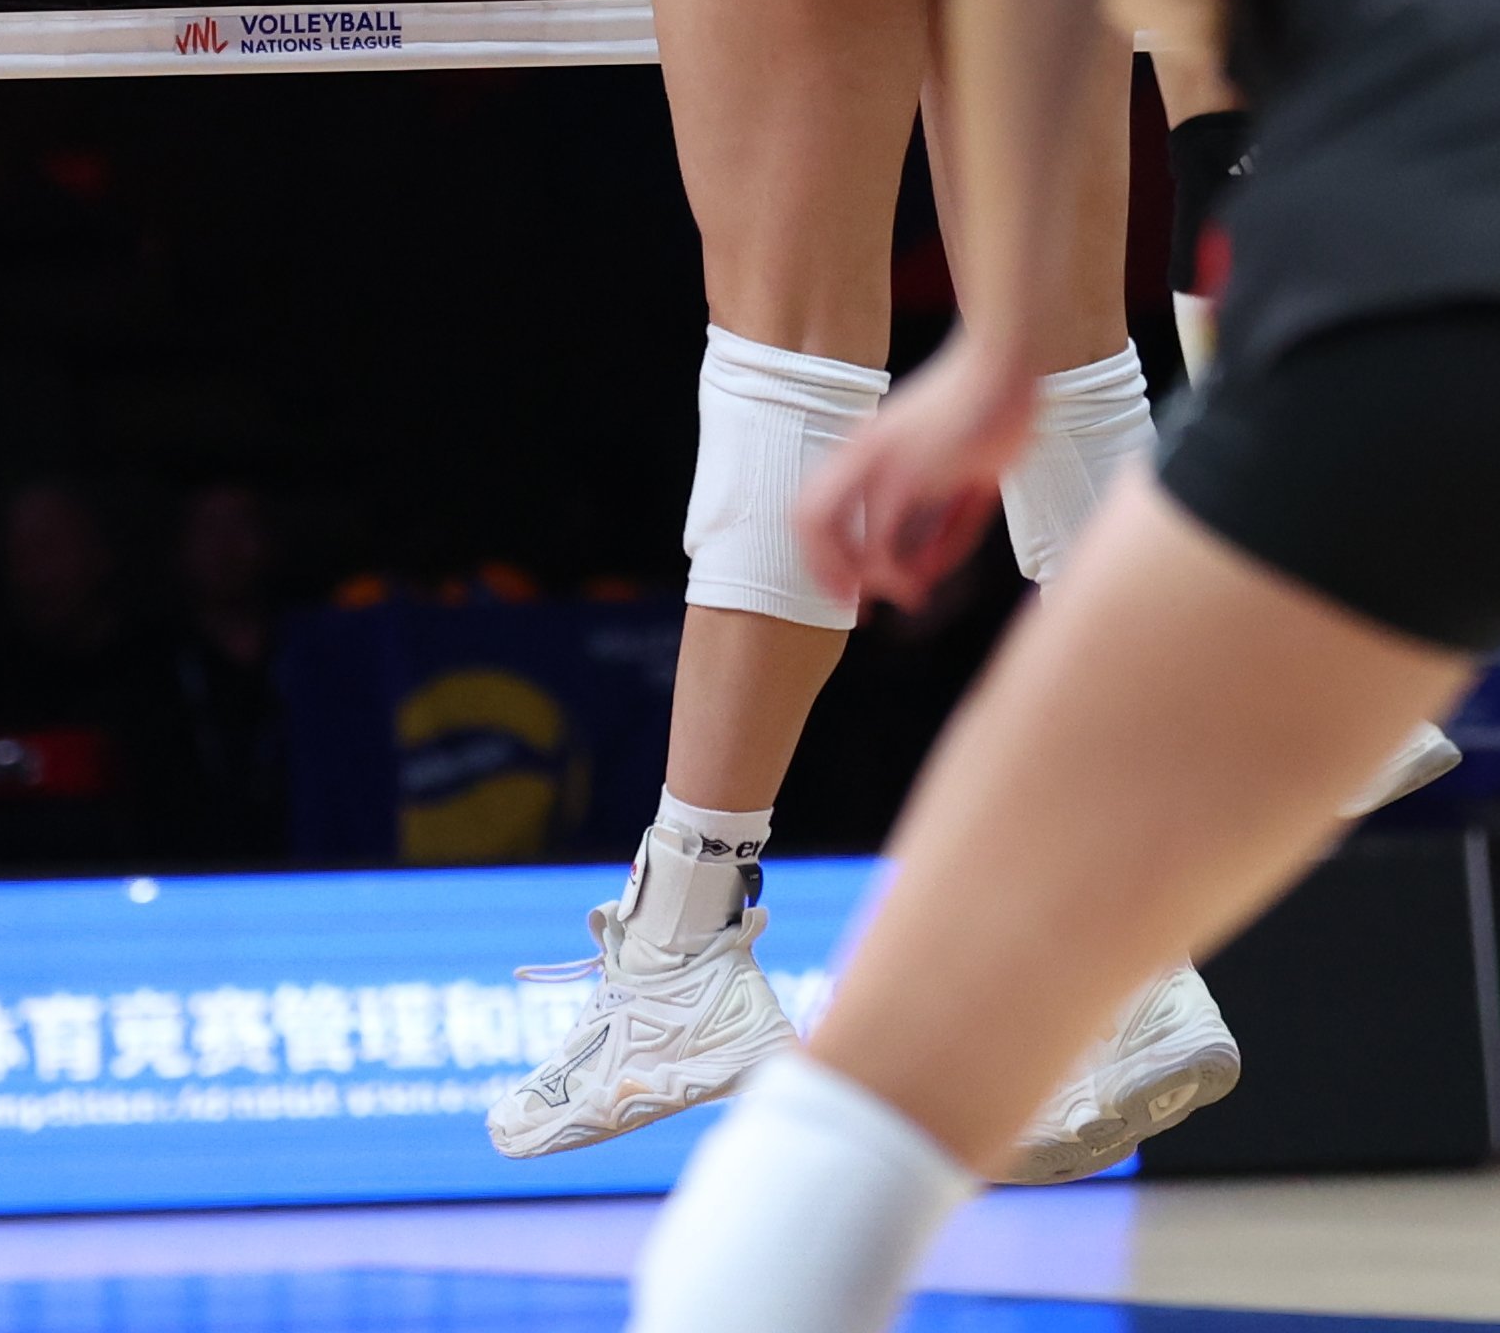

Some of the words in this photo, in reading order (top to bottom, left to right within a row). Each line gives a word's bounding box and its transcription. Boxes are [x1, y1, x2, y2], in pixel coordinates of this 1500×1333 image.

[241, 11, 402, 35] VOLLEYBALL
[176, 17, 228, 55] VNL
[241, 38, 323, 54] NATIONS
[331, 35, 403, 51] LEAGUE
